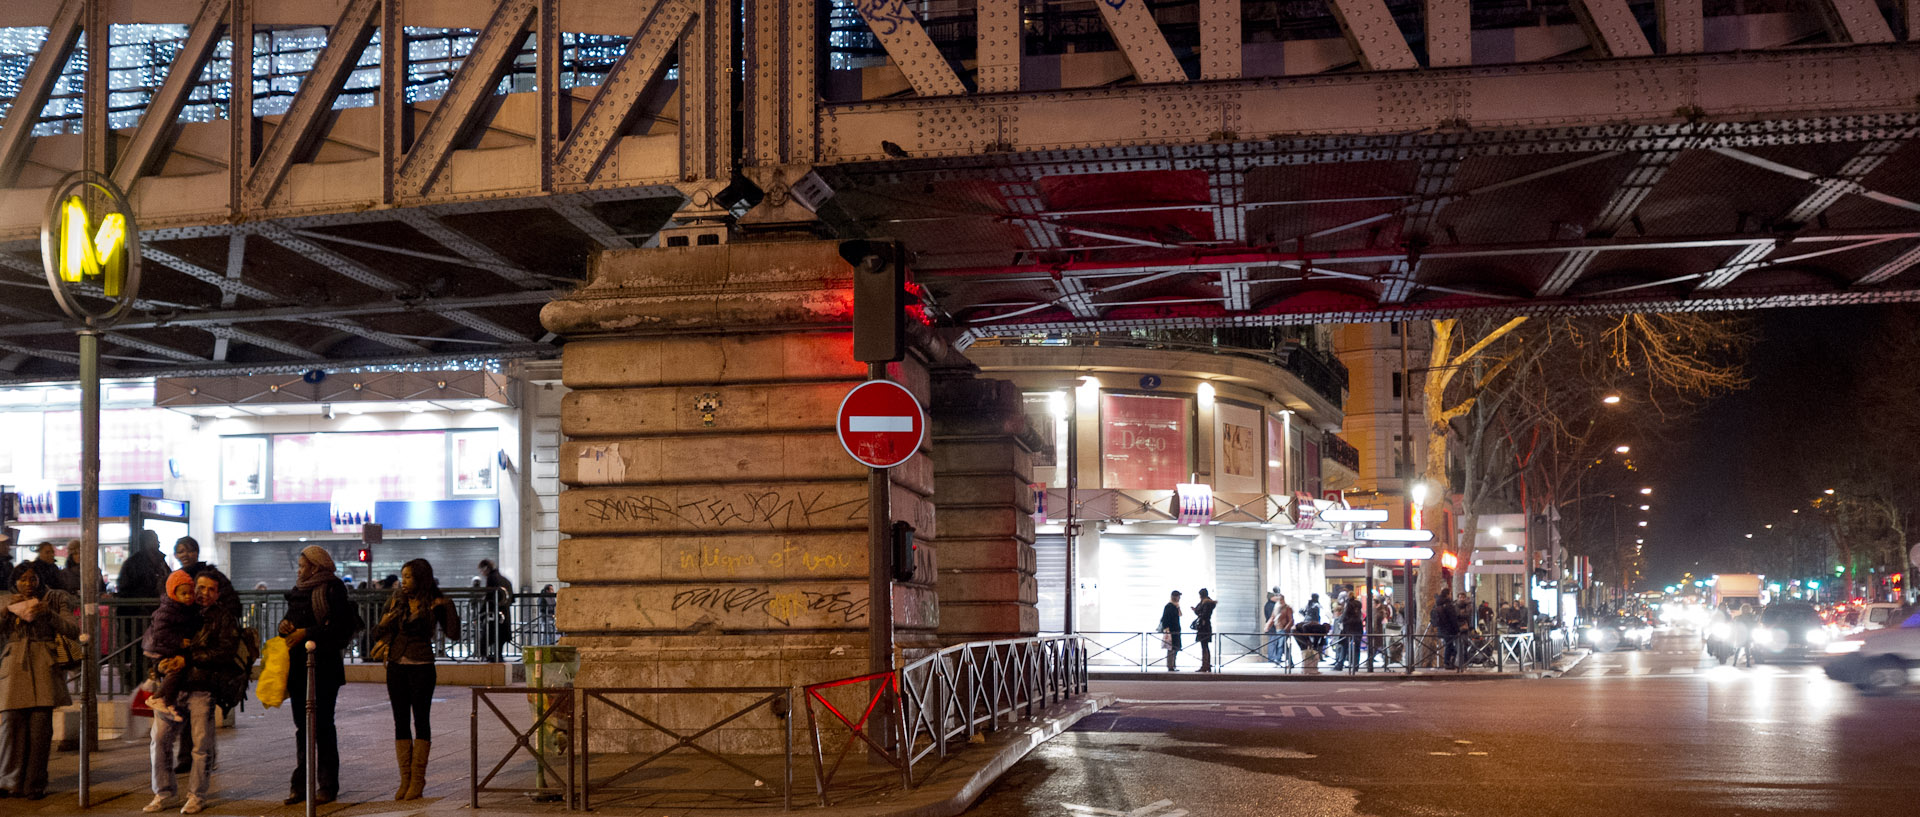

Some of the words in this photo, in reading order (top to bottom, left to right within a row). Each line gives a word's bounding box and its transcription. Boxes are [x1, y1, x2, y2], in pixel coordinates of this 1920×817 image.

[60, 195, 125, 296] M
[1121, 429, 1166, 451] Déco
[1183, 495, 1210, 516] TATI
[1224, 702, 1384, 718] BUS
